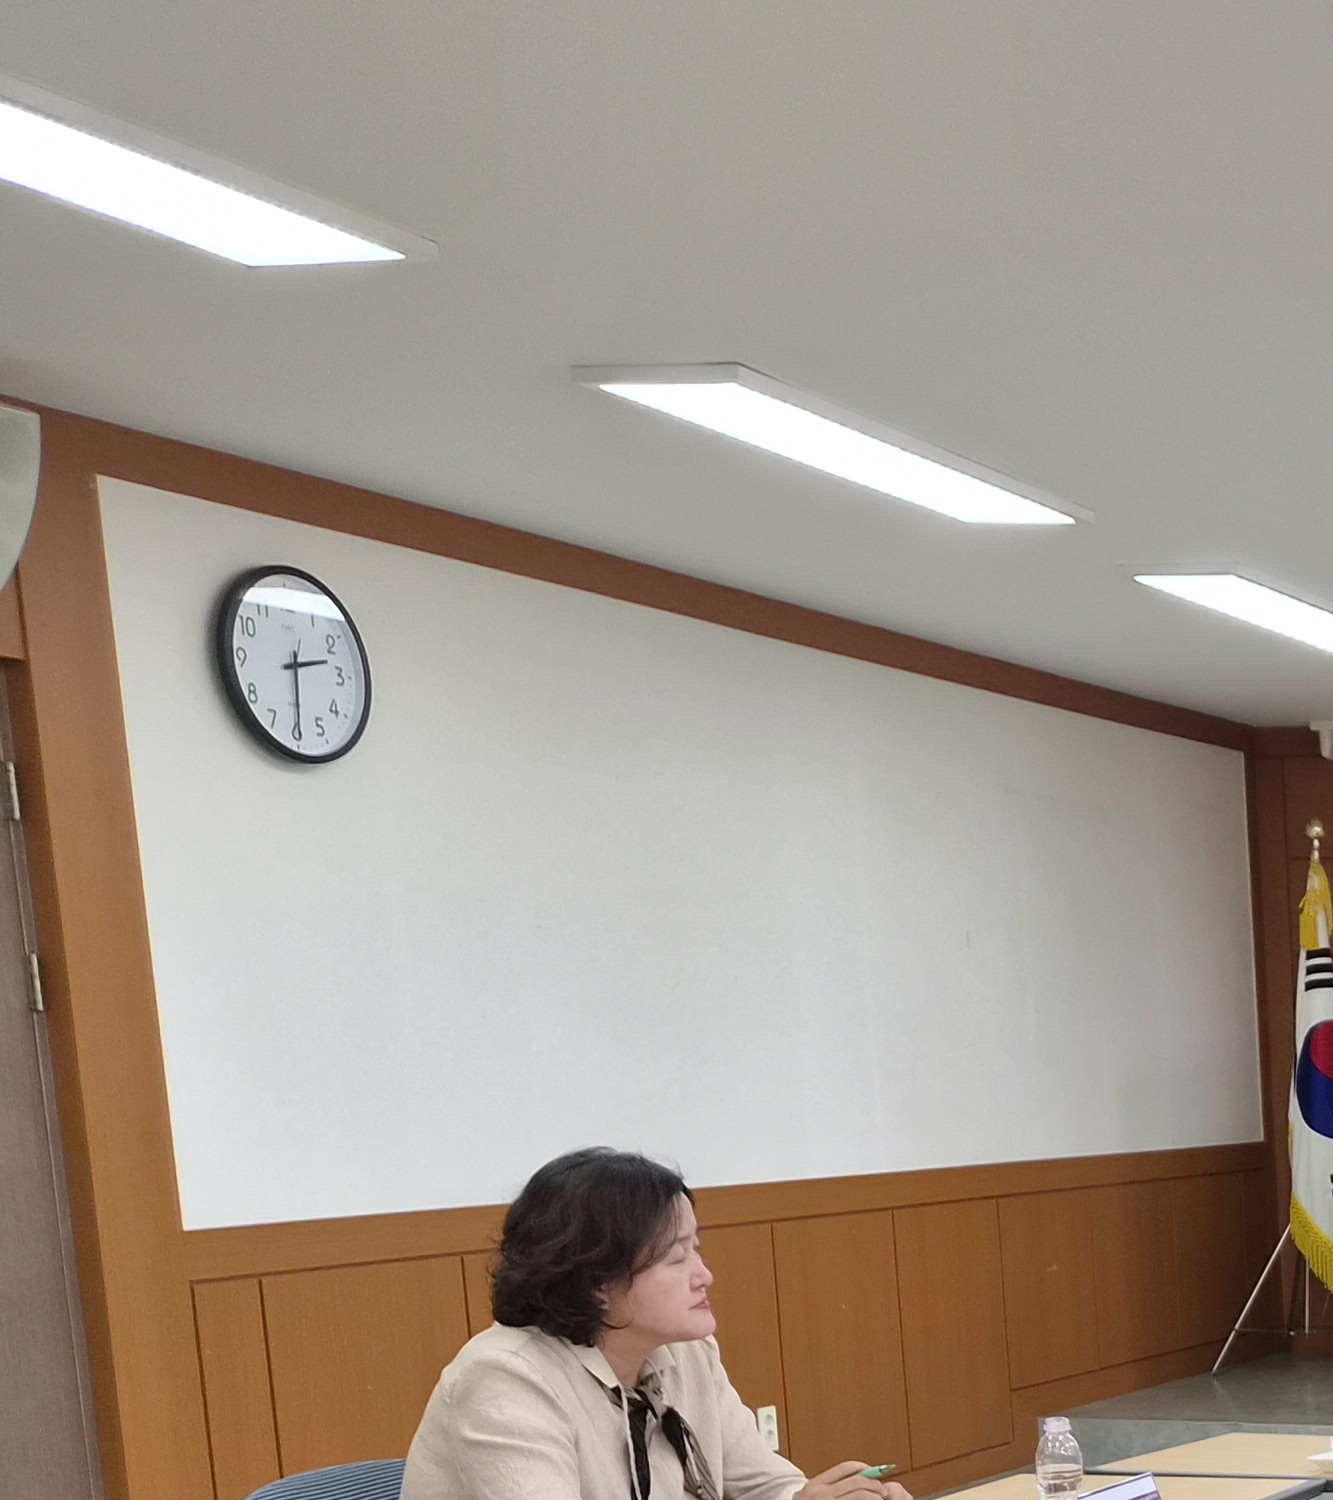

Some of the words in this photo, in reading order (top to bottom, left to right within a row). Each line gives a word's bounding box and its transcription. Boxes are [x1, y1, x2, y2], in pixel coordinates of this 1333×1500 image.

[239, 615, 256, 638] 10
[326, 634, 336, 655] 2
[236, 646, 247, 668] 9
[334, 666, 345, 686] 3
[247, 682, 258, 704] 8
[267, 708, 277, 729] 7
[329, 698, 339, 719] 4
[315, 717, 325, 737] 5
